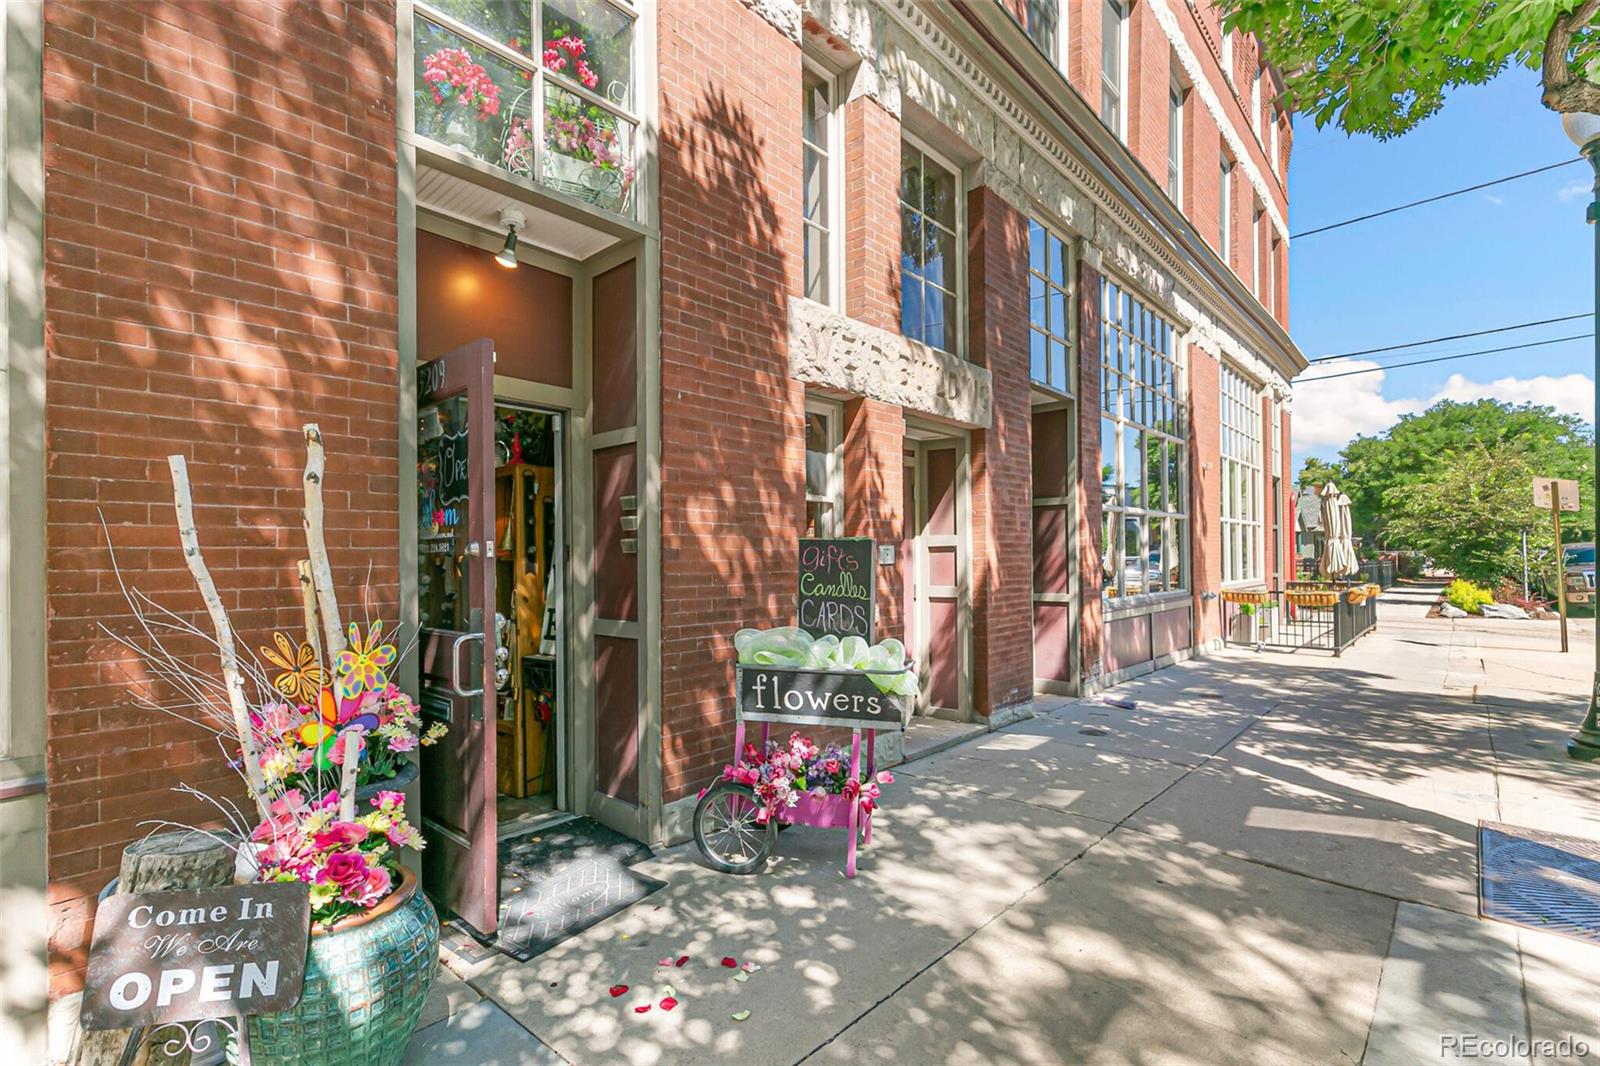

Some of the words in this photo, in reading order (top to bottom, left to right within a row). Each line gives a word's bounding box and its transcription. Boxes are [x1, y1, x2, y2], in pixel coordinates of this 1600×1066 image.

[800, 571, 870, 600] Candles
[800, 599, 868, 636] CARDS
[752, 674, 882, 714] flowers
[127, 904, 228, 929] Come
[237, 897, 274, 921] In
[144, 932, 191, 959] We
[197, 928, 259, 955] Are
[109, 960, 280, 1010] OPEN
